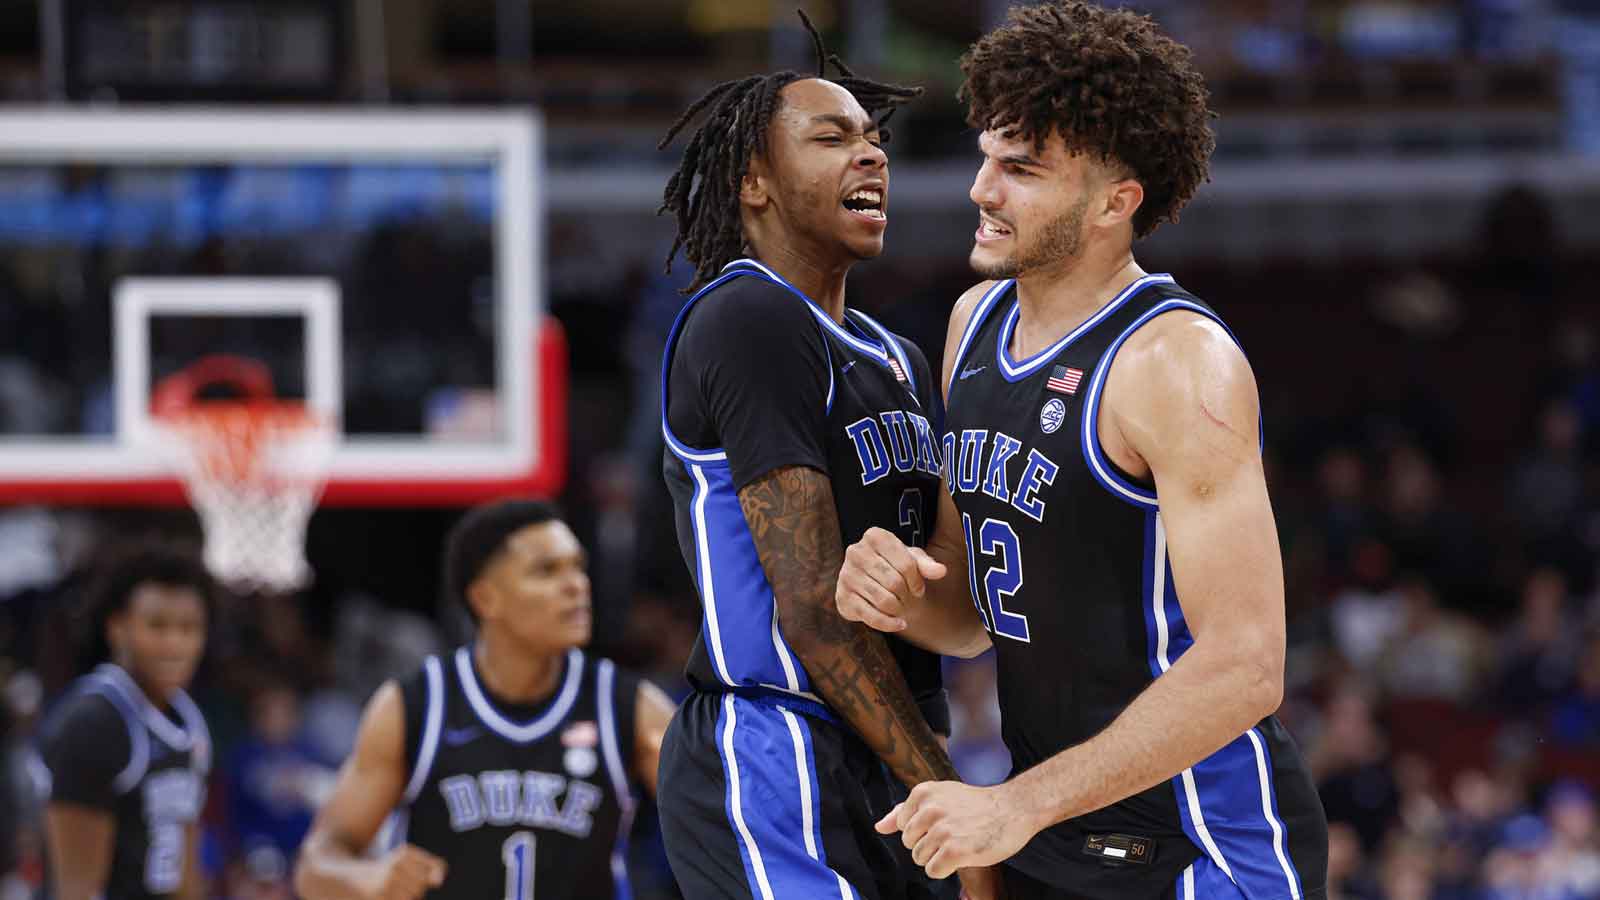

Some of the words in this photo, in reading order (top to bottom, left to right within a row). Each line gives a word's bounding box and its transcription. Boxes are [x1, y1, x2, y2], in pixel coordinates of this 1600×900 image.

[845, 411, 944, 486] DUK
[438, 769, 602, 839] DUKE
[502, 830, 537, 900] 1
[1130, 843, 1145, 856] 50
